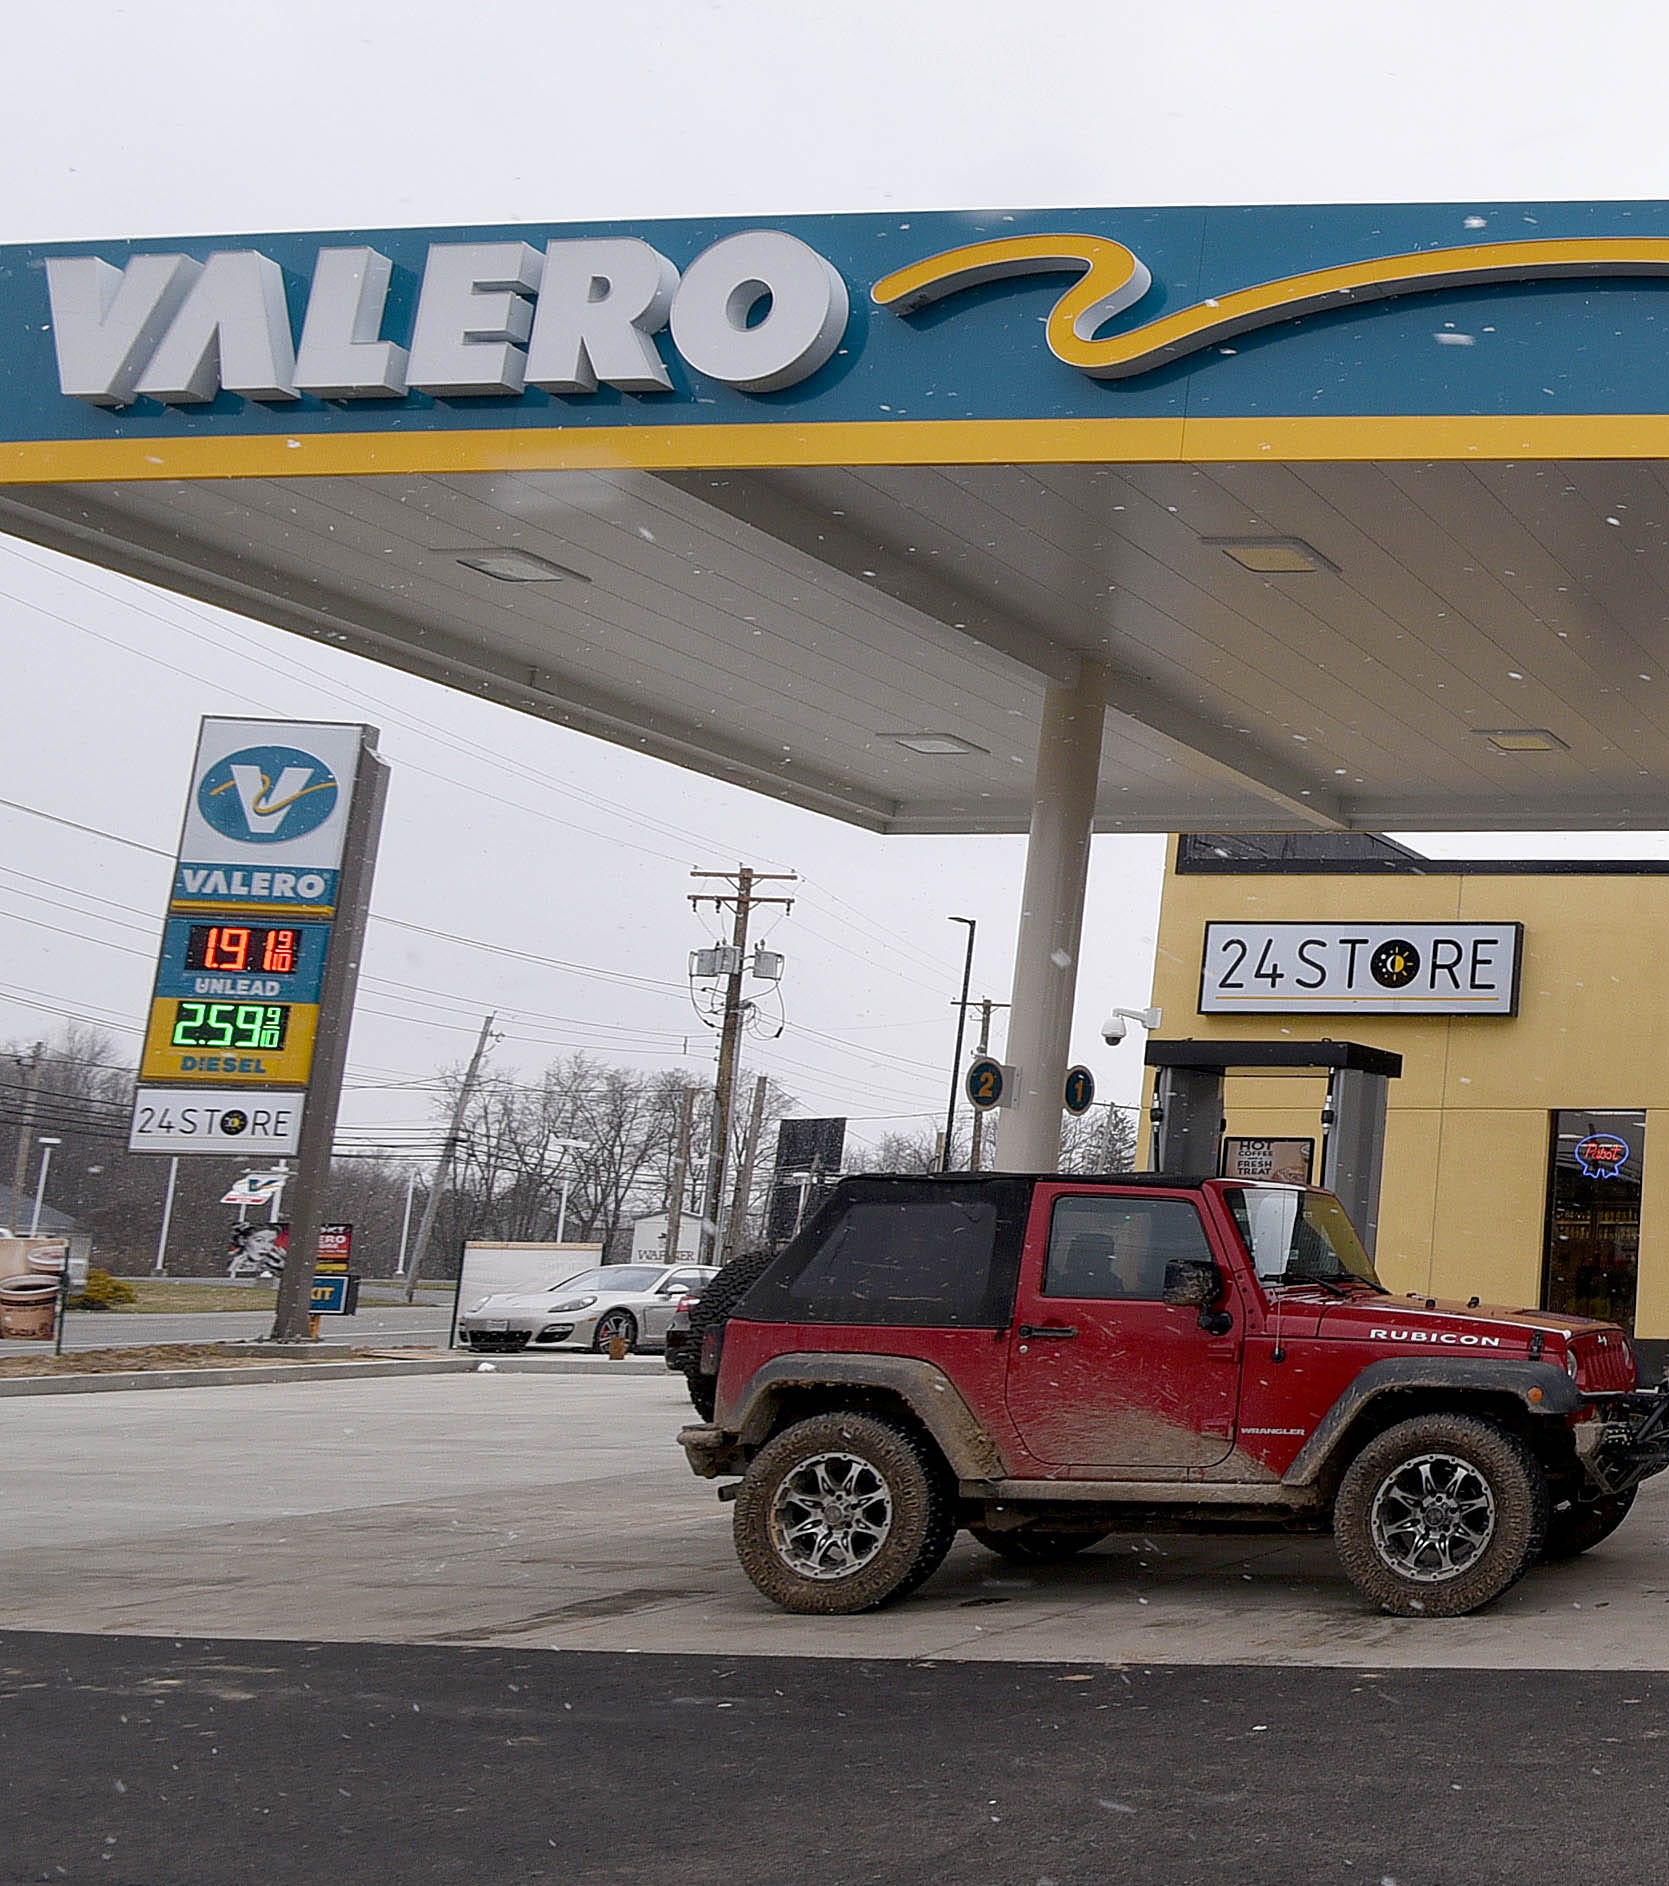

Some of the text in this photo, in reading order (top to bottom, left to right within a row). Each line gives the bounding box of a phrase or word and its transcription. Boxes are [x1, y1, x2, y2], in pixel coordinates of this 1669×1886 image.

[44, 229, 850, 405] VALERO
[182, 868, 326, 899] VALERO
[1218, 938, 1499, 989] 24STORE
[194, 978, 280, 997] UNLEAD
[181, 1056, 266, 1074] DIESEL
[978, 1072, 995, 1097] 2
[1074, 1079, 1084, 1103] 1
[137, 1107, 293, 1137] 24STORE
[1239, 1140, 1274, 1150] HOT
[1370, 1329, 1500, 1347] RUBICON
[1241, 1427, 1305, 1436] WRANGLER
